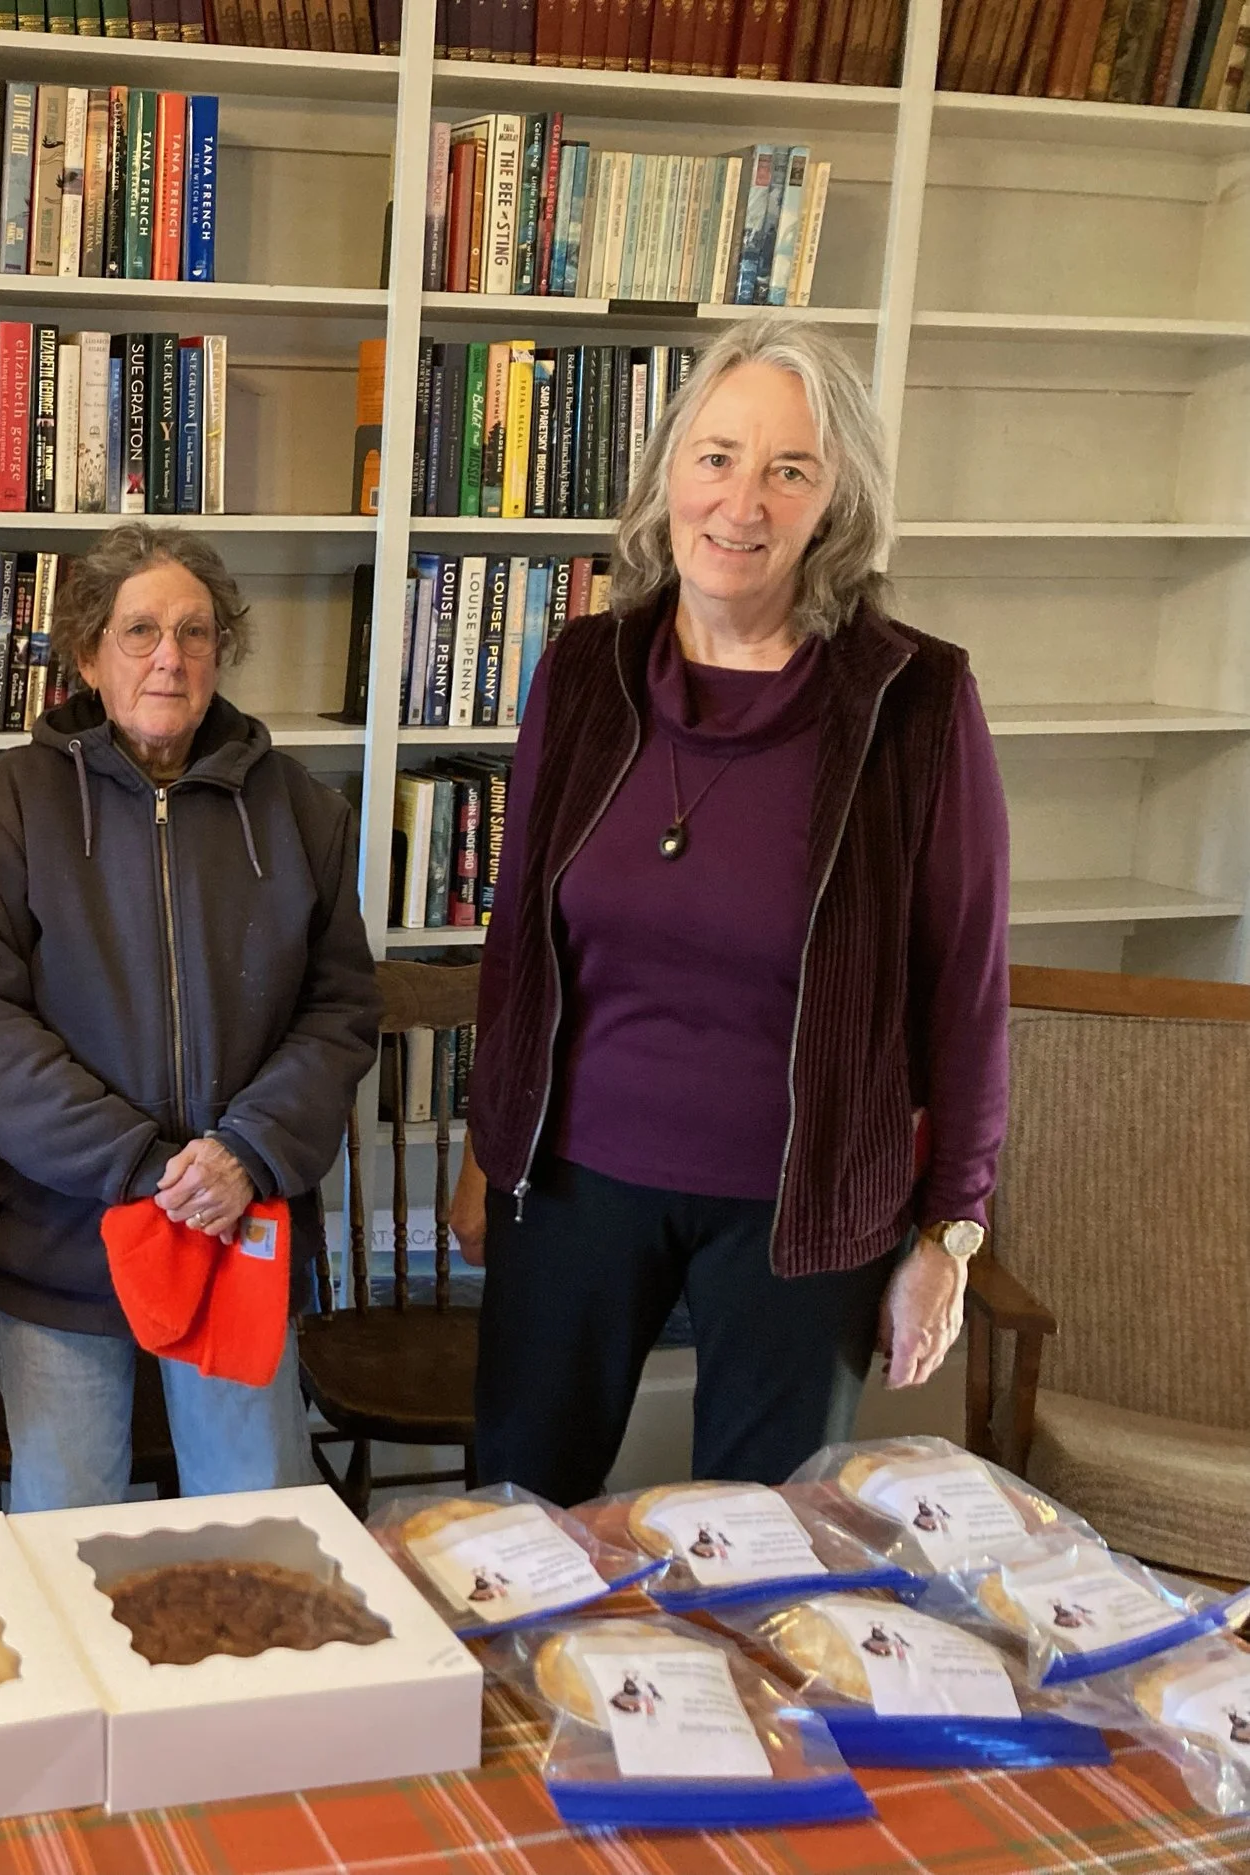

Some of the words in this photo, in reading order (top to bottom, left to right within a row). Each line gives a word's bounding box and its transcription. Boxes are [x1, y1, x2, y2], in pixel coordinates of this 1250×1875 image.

[12, 110, 30, 130] THE
[14, 93, 31, 108] TO
[11, 133, 29, 157] HILT
[142, 131, 152, 173] TANA
[171, 133, 181, 173] TANA
[203, 136, 213, 176] TANA
[436, 131, 446, 165] LORRIE
[500, 150, 515, 177] THE
[550, 124, 562, 171] GRANITE
[139, 178, 151, 236] FRENCH
[433, 168, 445, 206] MOORE
[498, 182, 513, 207] BEE
[545, 174, 557, 219] HARBOR
[168, 180, 180, 238] FRENCH
[202, 183, 213, 240] FRENCH
[494, 221, 511, 267] STING
[40, 329, 55, 378] ELIZABETH
[131, 344, 145, 375] SUE
[163, 339, 173, 361] SUE
[189, 352, 197, 370] SUE
[566, 354, 575, 386] Robert
[13, 339, 28, 418] elizabeth
[38, 379, 54, 416] GEORGE
[163, 363, 173, 418] GRAFTON
[187, 372, 197, 419] GRAFTON
[434, 372, 442, 417] HAMNET
[518, 379, 527, 409] TOTAL
[540, 386, 550, 408] SARA
[620, 374, 628, 418] TELLING
[130, 379, 144, 460] GRAFTON
[471, 393, 484, 427] Bullet
[537, 409, 548, 451] PARETSKY
[564, 396, 573, 425] Parker
[160, 422, 174, 441] Y
[516, 414, 525, 450] RECALL
[618, 422, 626, 452] ROOM
[10, 426, 24, 481] george
[468, 447, 480, 488] MISSED
[560, 426, 572, 480] Melancholy
[126, 472, 145, 494] X
[535, 453, 546, 506] BREAKDOWN
[559, 481, 569, 504] Baby
[440, 563, 456, 621] LOUISE
[466, 572, 481, 629] LOUISE
[490, 572, 505, 632] LOUISE
[554, 564, 569, 621] LOUISE
[434, 644, 450, 697] PENNY
[460, 647, 474, 701] PENNY
[485, 645, 500, 700] PENNY
[468, 788, 478, 816] JOHN
[490, 777, 506, 813] JOHN
[465, 818, 476, 869] SANDFORD
[482, 887, 494, 908] PREY
